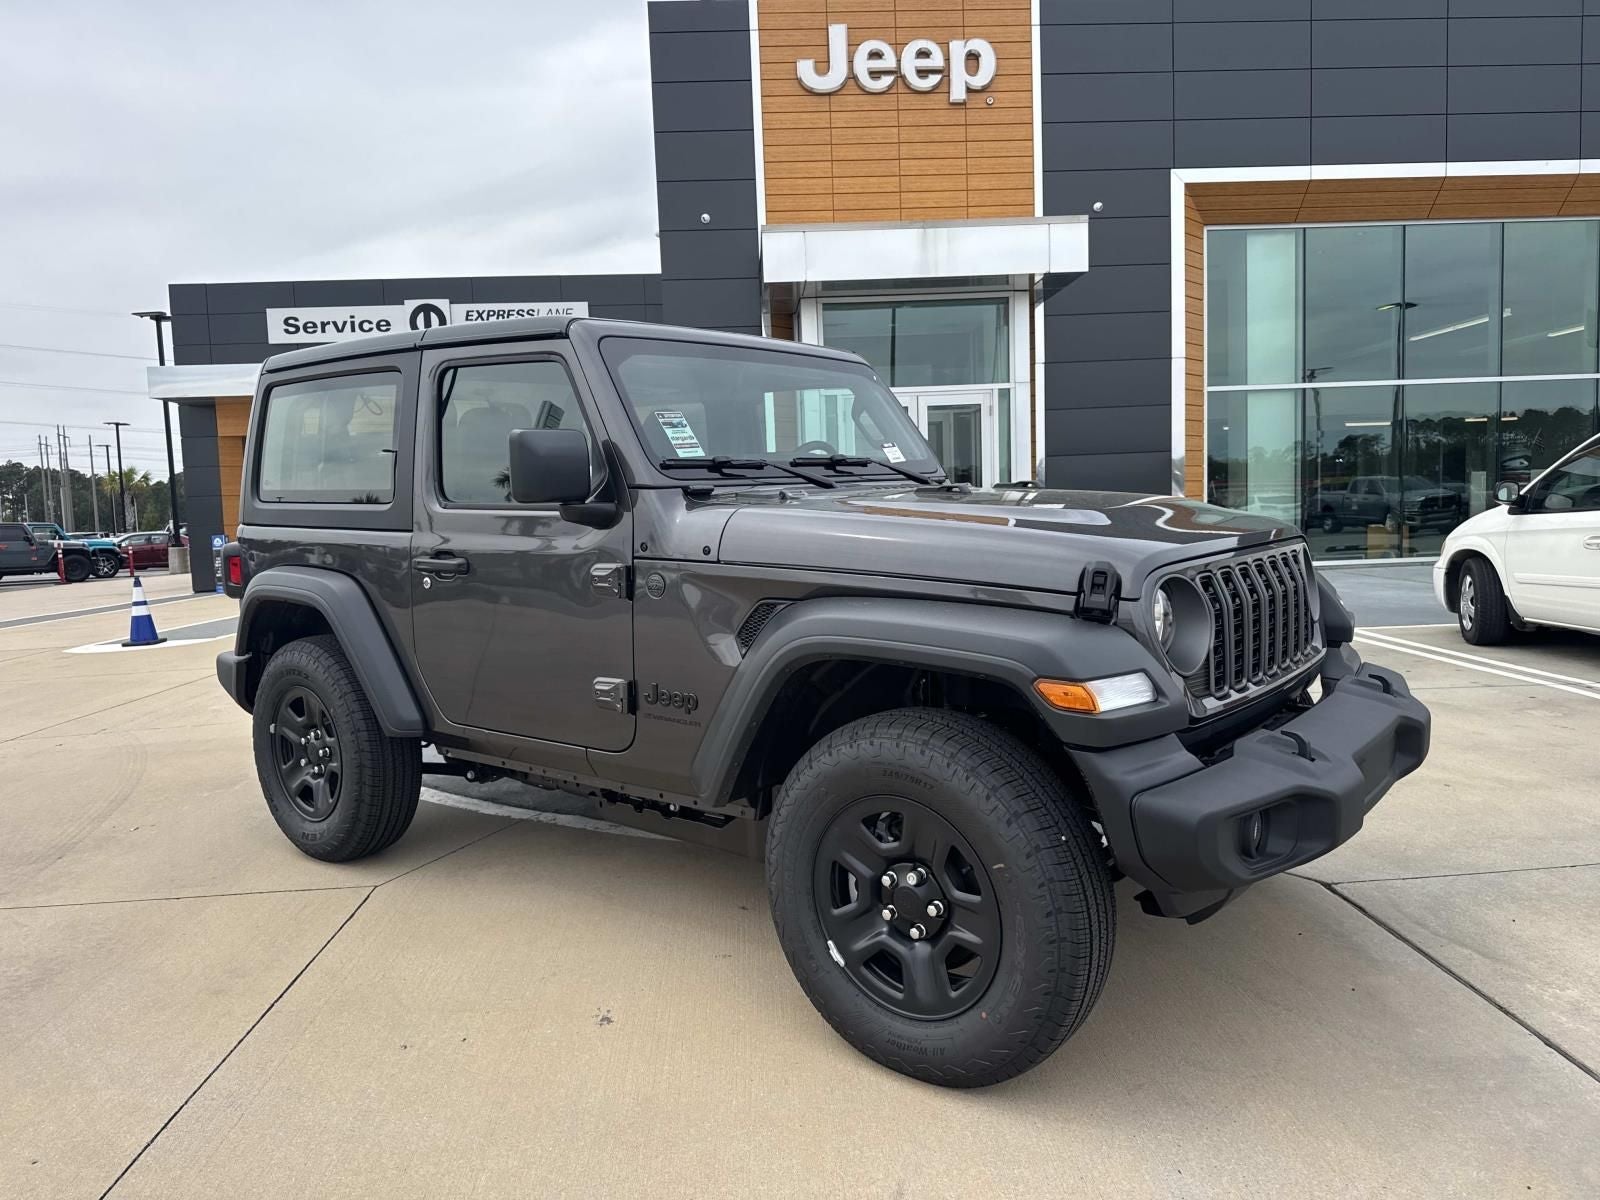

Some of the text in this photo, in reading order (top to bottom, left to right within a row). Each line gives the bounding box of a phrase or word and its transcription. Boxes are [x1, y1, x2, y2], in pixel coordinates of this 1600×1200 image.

[797, 23, 997, 104] Jeep
[283, 314, 392, 335] Service
[642, 682, 699, 715] Jeep
